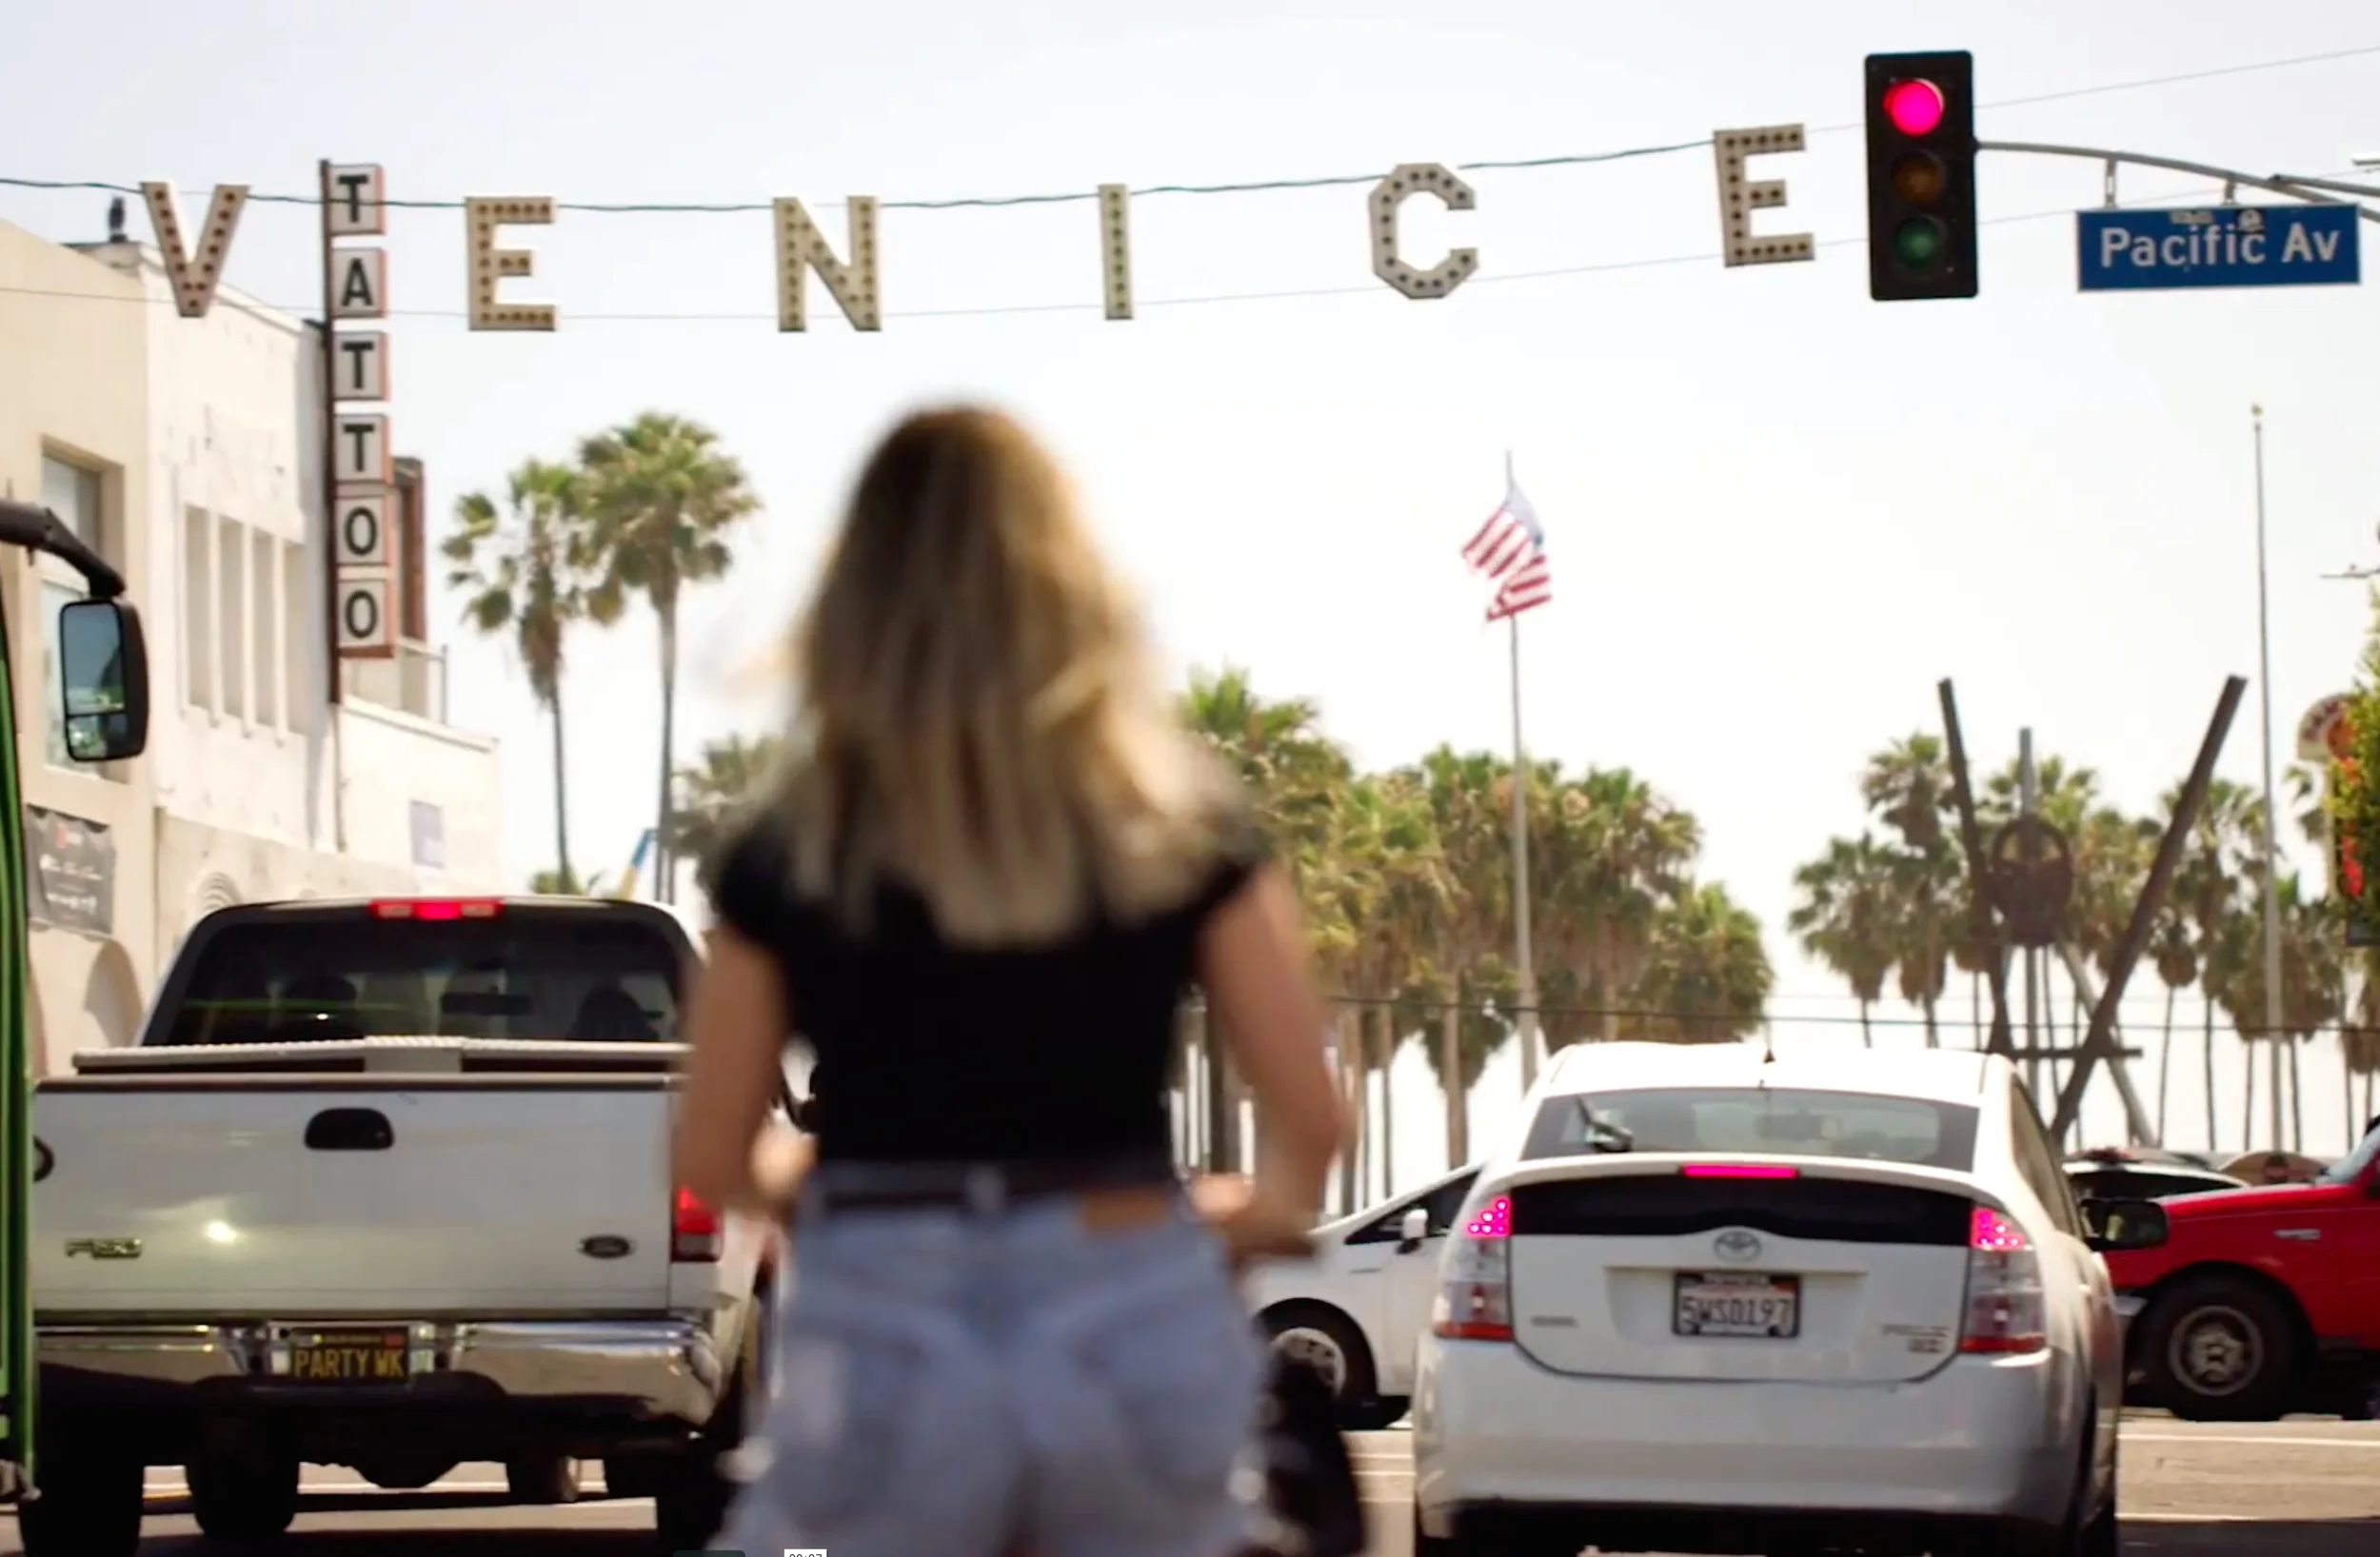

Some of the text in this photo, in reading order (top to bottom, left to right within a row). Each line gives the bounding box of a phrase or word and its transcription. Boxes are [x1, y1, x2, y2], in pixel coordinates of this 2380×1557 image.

[141, 124, 1816, 332] VENICE
[2100, 221, 2340, 267] Pacific Av
[336, 173, 379, 640] TATTOO
[294, 1349, 369, 1378] PARTY
